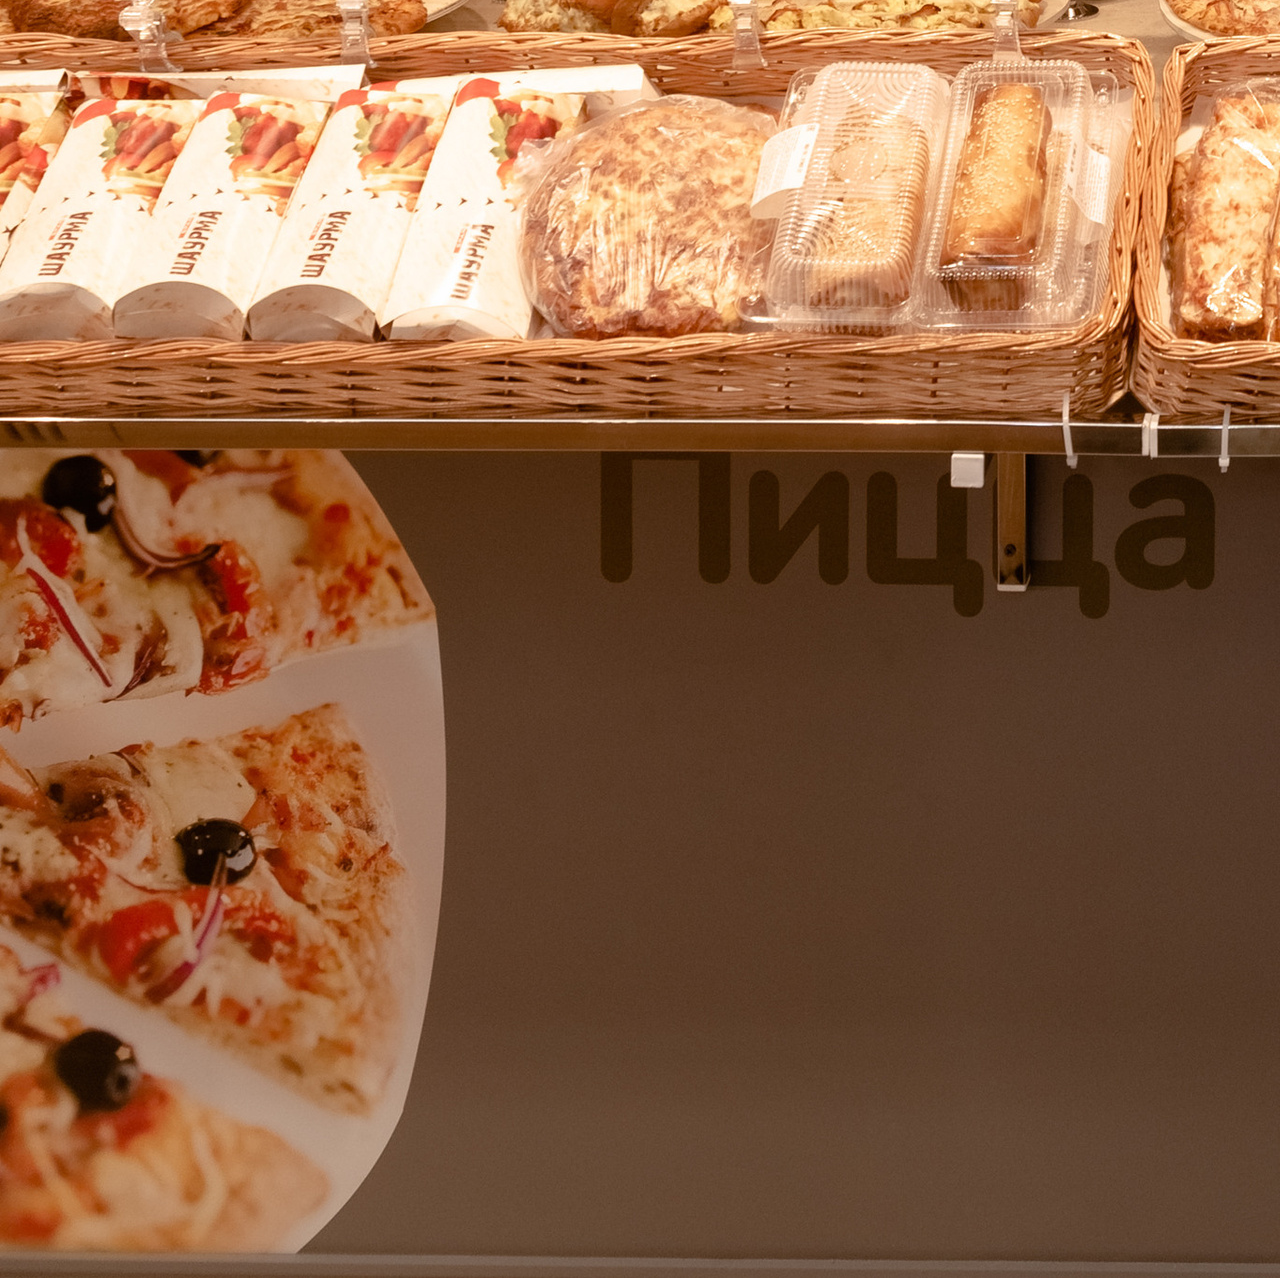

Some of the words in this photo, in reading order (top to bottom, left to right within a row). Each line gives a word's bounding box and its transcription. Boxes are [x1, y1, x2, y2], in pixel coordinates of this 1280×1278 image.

[38, 211, 93, 277] ШАУРМА
[169, 211, 222, 276] ШАУРМА
[300, 211, 351, 278] ШАУРМА
[450, 224, 494, 300] ШАУРМА
